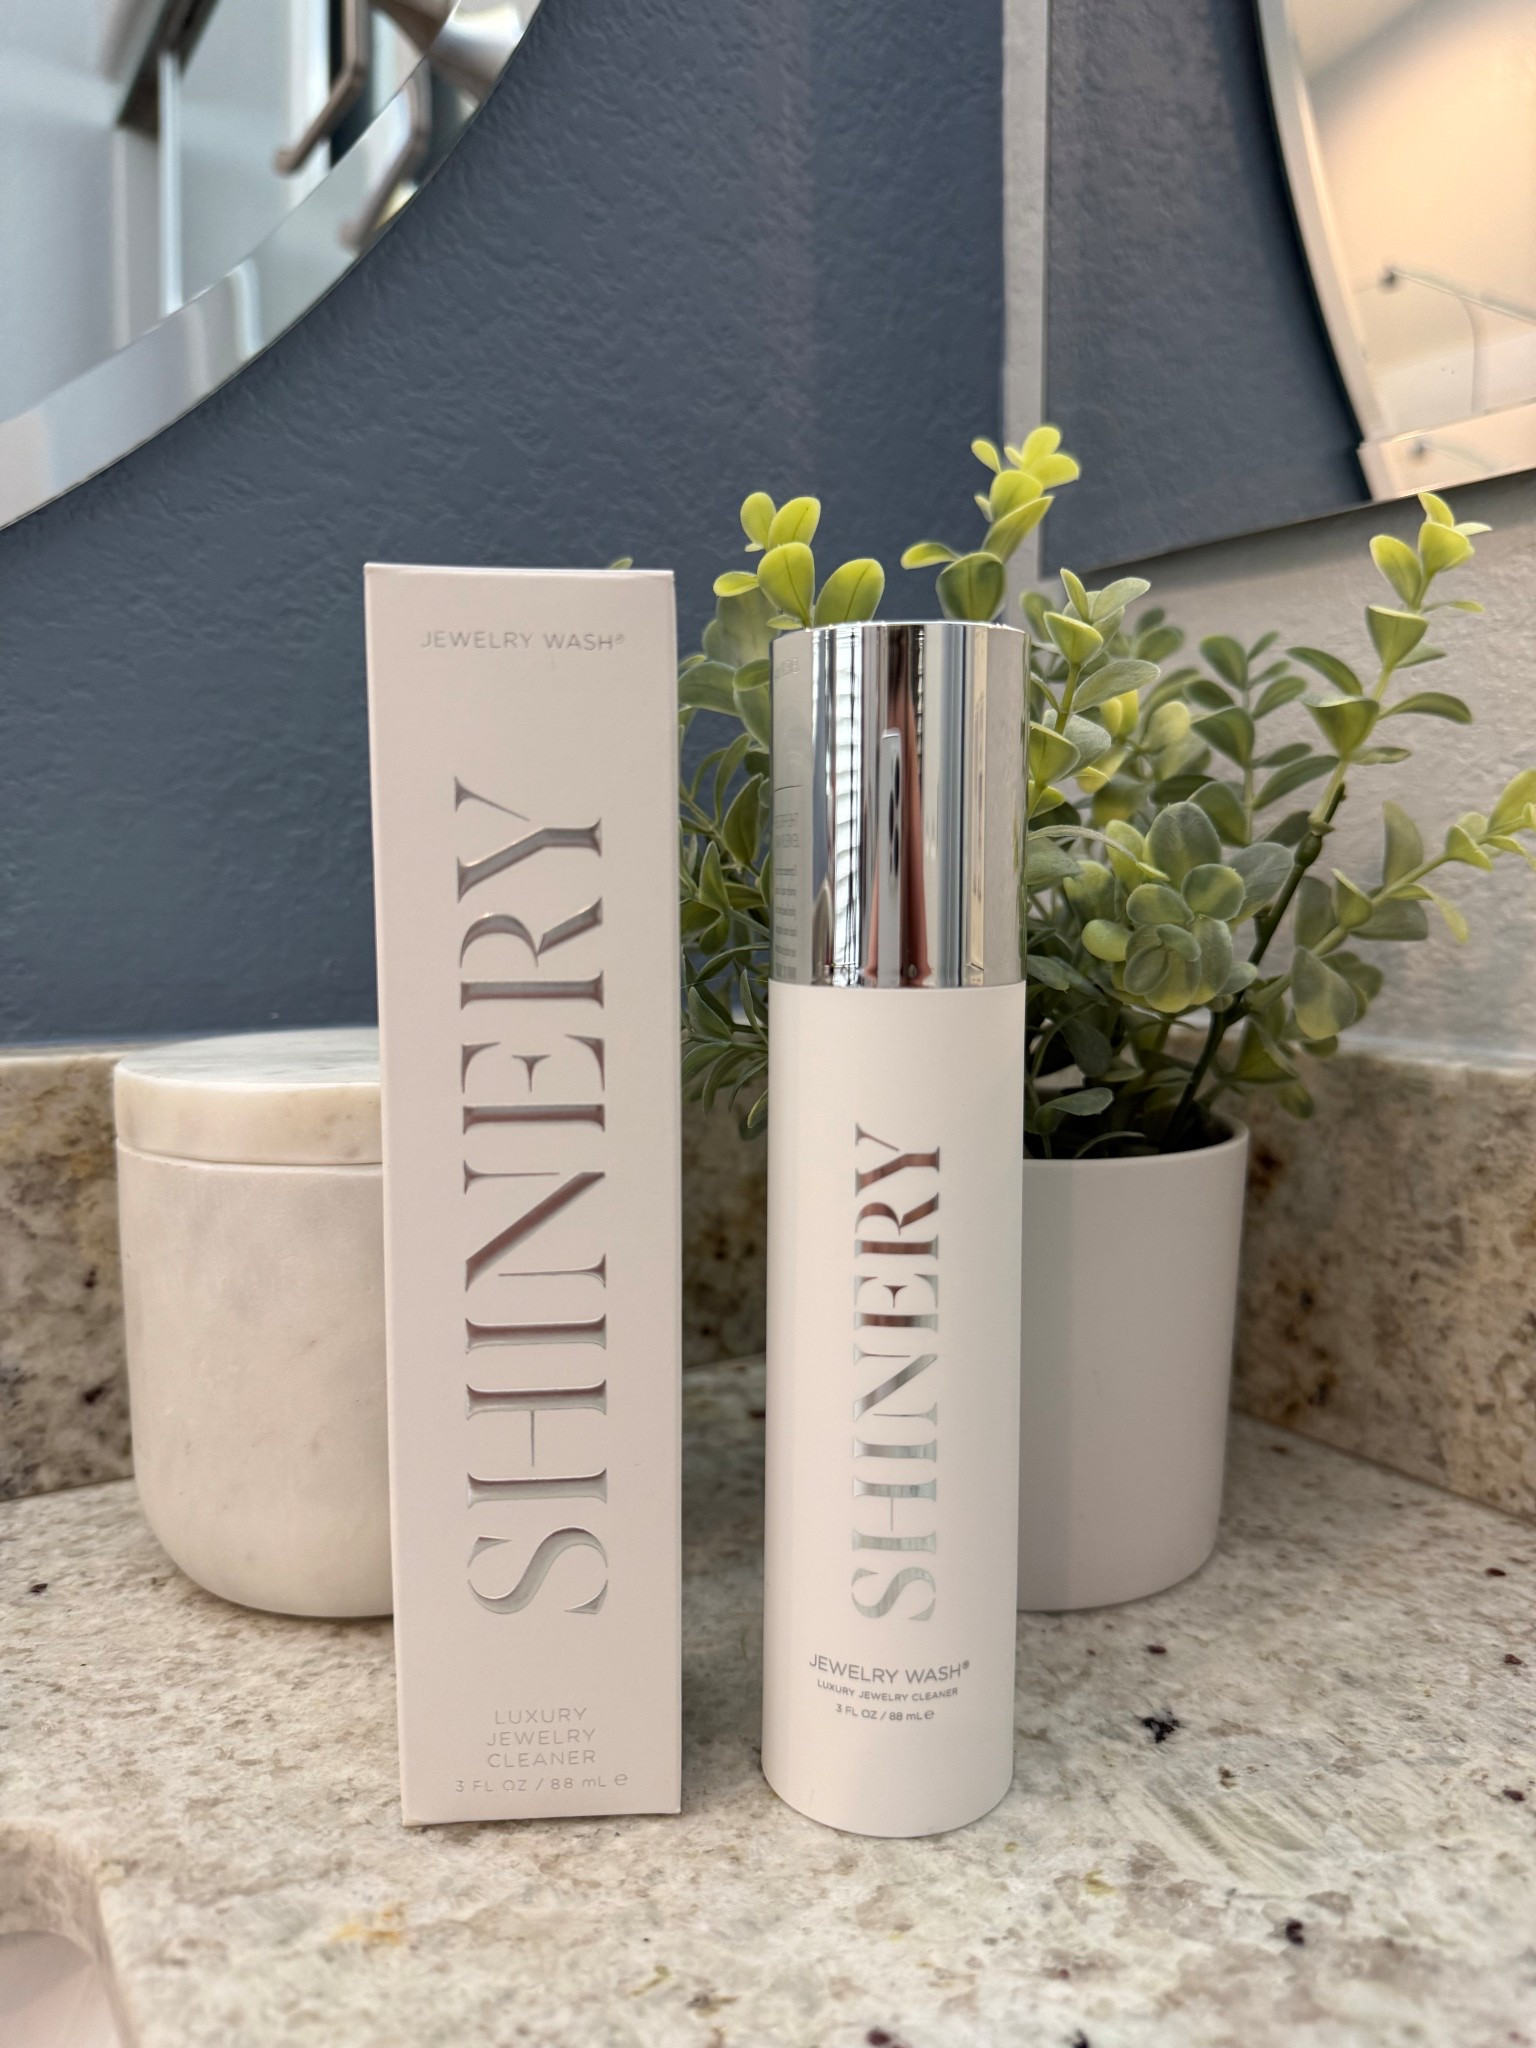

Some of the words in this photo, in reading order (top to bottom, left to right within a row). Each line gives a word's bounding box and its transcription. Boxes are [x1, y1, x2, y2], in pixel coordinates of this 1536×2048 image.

[420, 630, 534, 649] JEWELRY
[454, 776, 609, 1615] SHINERY
[851, 1123, 940, 1622] SHINERY
[809, 1653, 899, 1684] JEWELRY
[817, 1679, 855, 1696] LUXURY
[858, 1690, 909, 1702] JEWELRY
[911, 1687, 959, 1702] CLEANER
[494, 1707, 587, 1725] LUXURY
[835, 1703, 843, 1713] 3
[845, 1705, 858, 1717] FL
[861, 1708, 878, 1720] OZ
[889, 1711, 903, 1721] 88
[906, 1711, 923, 1721] mL
[486, 1728, 596, 1747] JEWELRY
[487, 1749, 596, 1768] CLEANER
[455, 1780, 465, 1793] 3
[472, 1780, 494, 1793] FL
[502, 1779, 527, 1792] OZ
[535, 1778, 544, 1791] /
[551, 1778, 574, 1790] 88
[582, 1776, 606, 1788] mL
